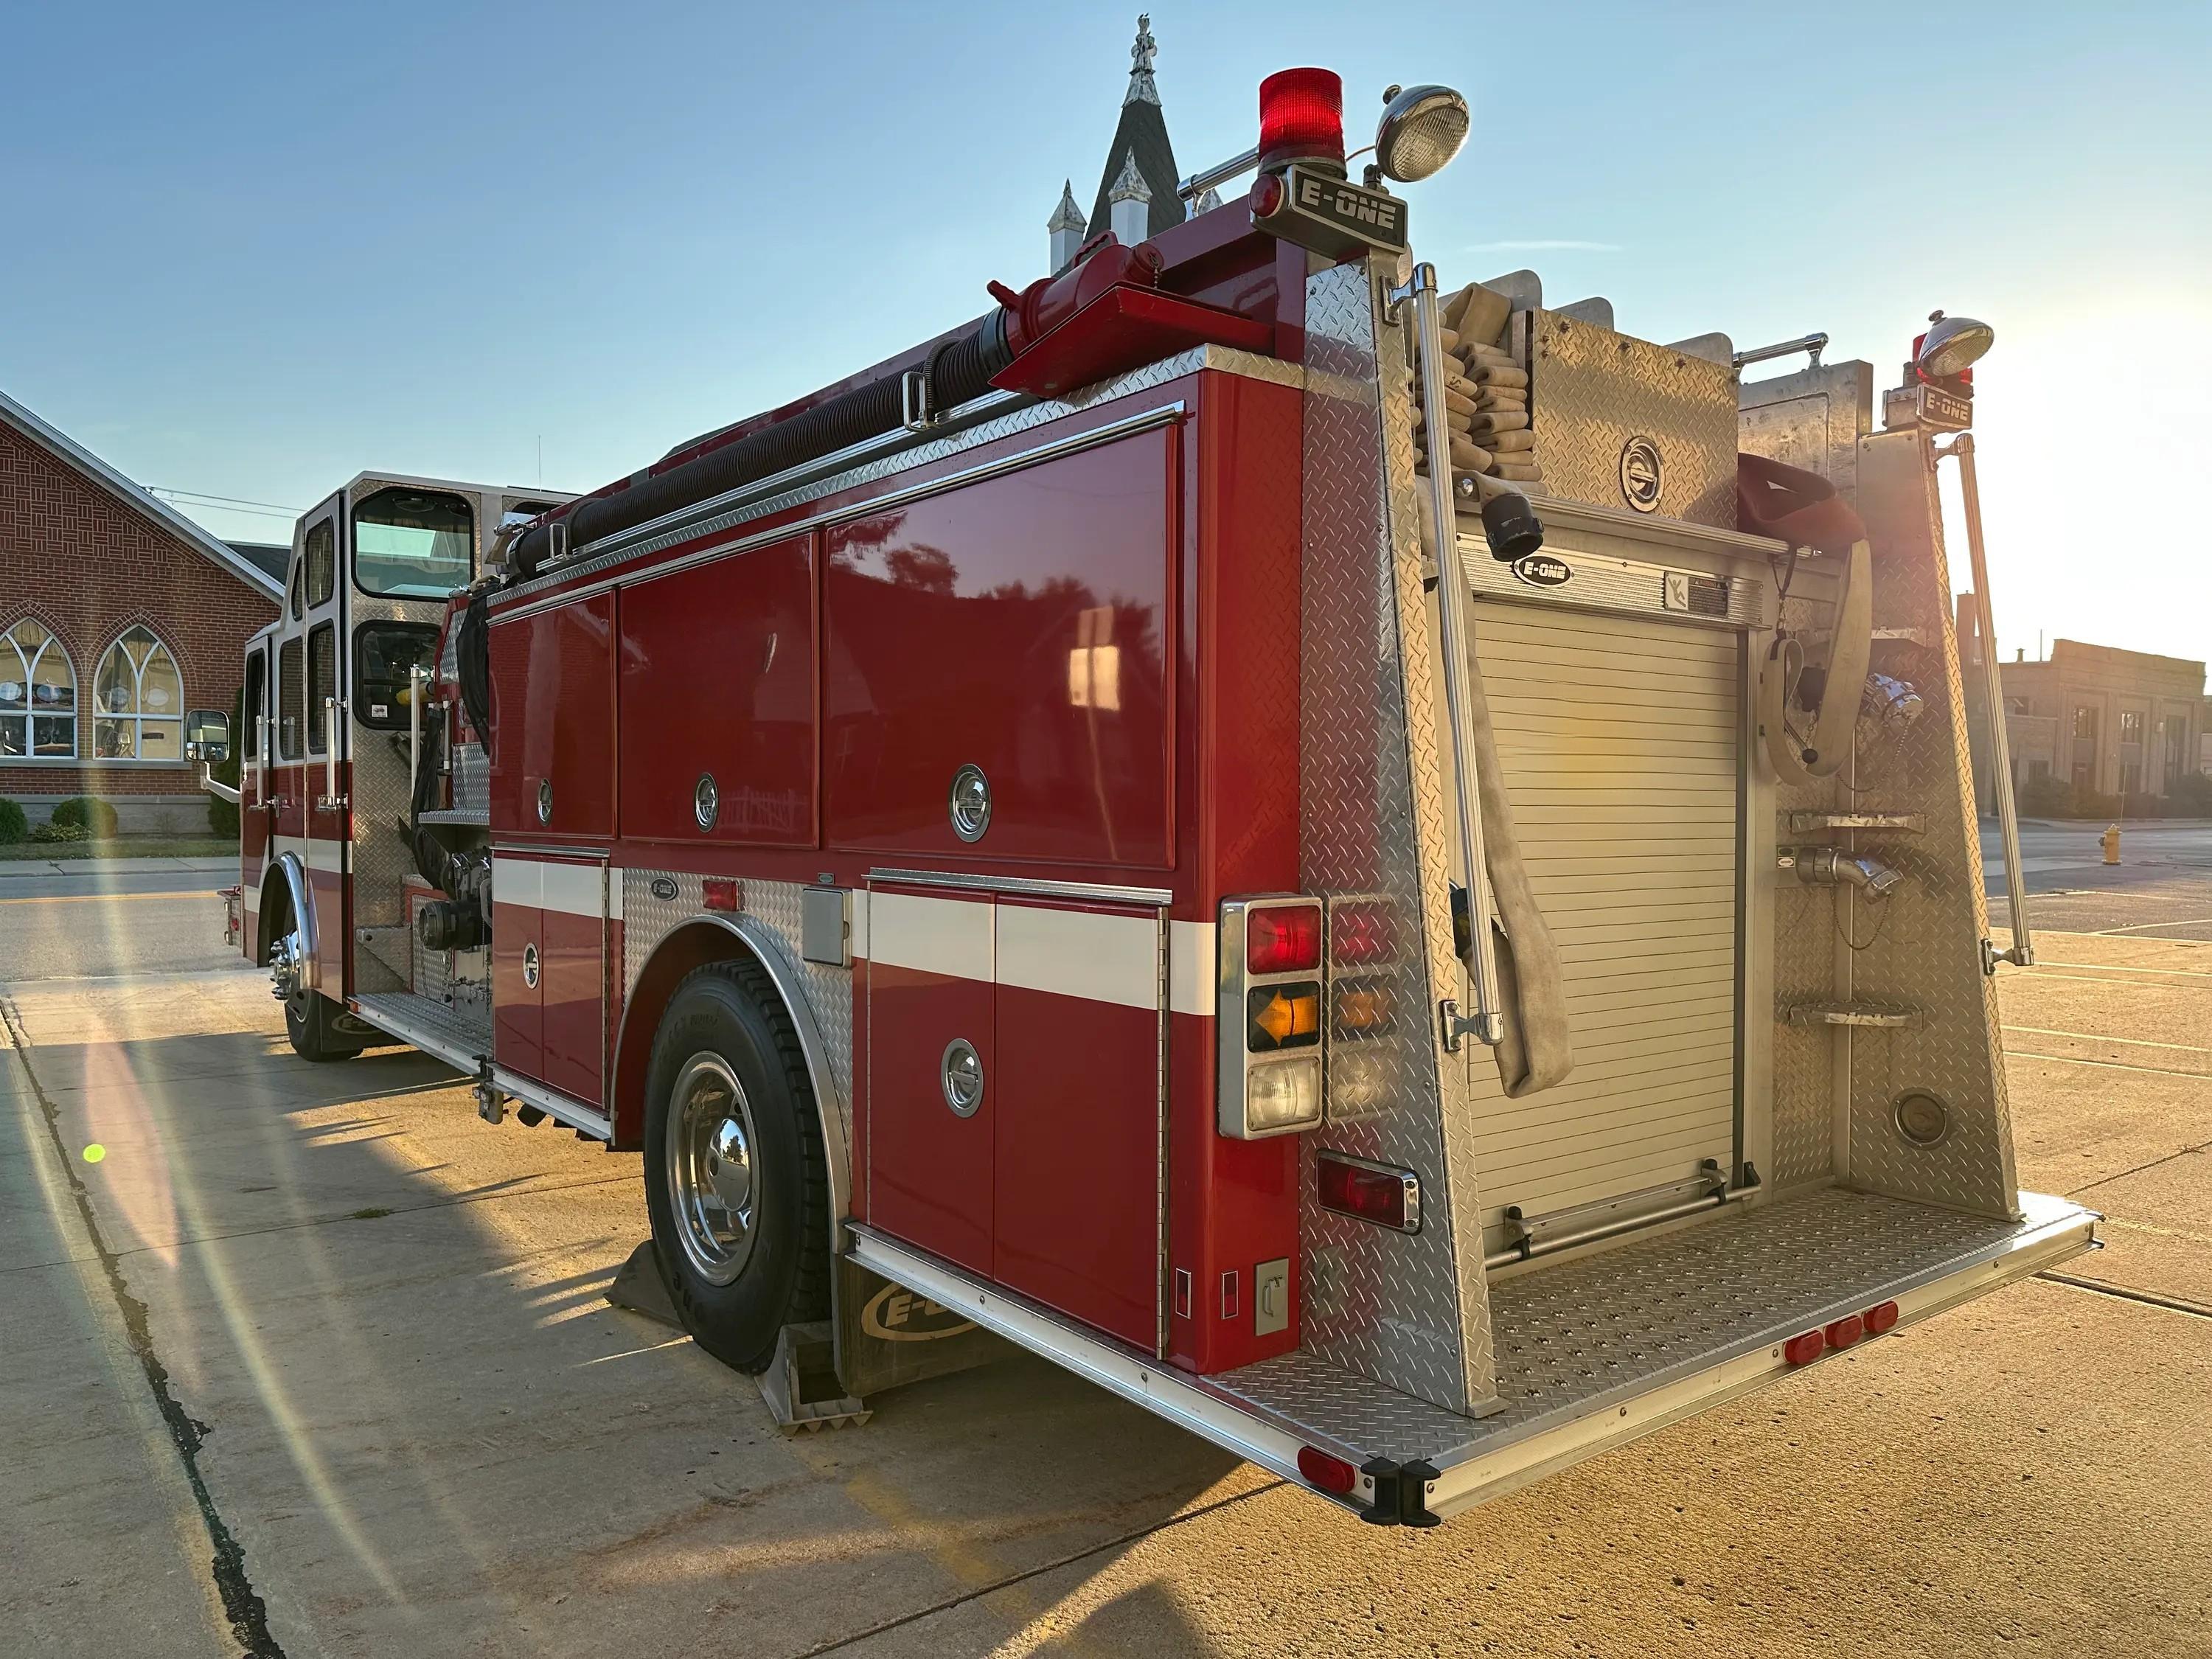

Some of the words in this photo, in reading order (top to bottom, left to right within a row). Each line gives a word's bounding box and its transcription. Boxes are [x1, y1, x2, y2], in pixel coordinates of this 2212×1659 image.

[1301, 178, 1397, 230] E-ONE
[1926, 392, 1969, 421] E-ONE
[1523, 561, 1567, 580] E-ONE
